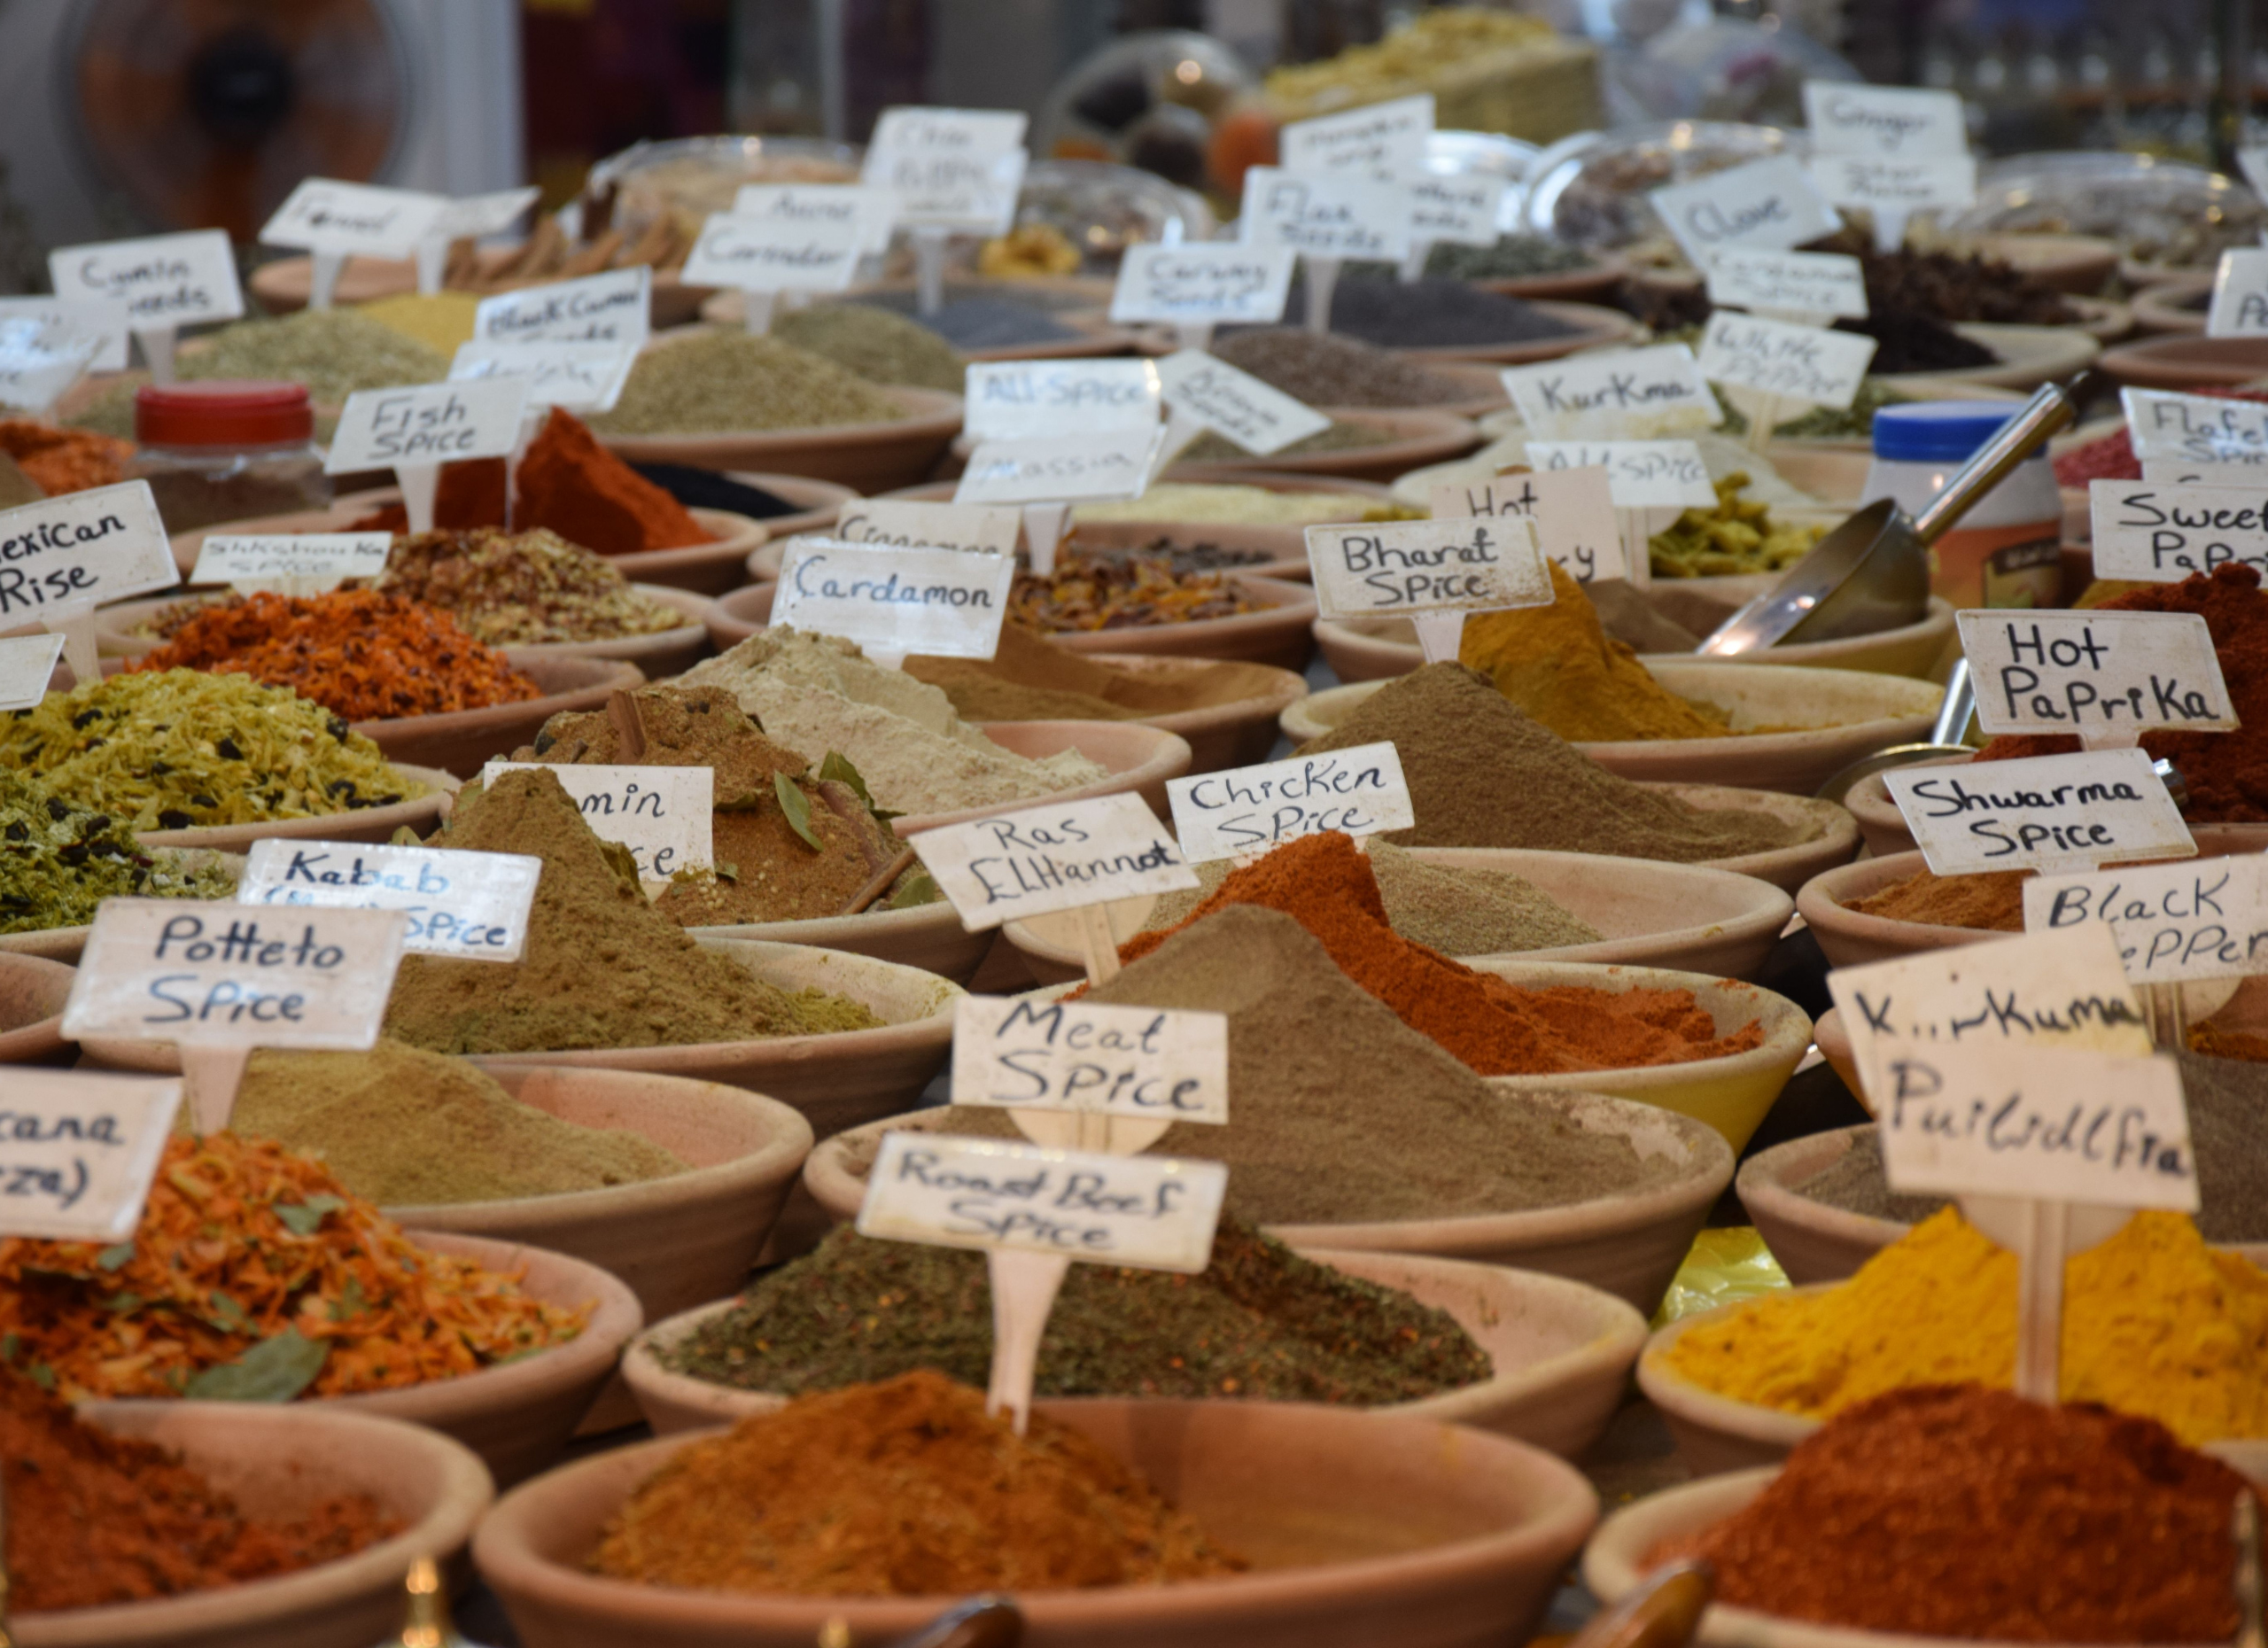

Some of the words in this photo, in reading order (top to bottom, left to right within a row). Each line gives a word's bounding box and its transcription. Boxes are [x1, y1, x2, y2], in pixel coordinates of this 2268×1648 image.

[2007, 623, 2109, 671] Hot
[580, 782, 666, 819] min
[975, 818, 1090, 851] Ras
[996, 1000, 1166, 1056] Meat
